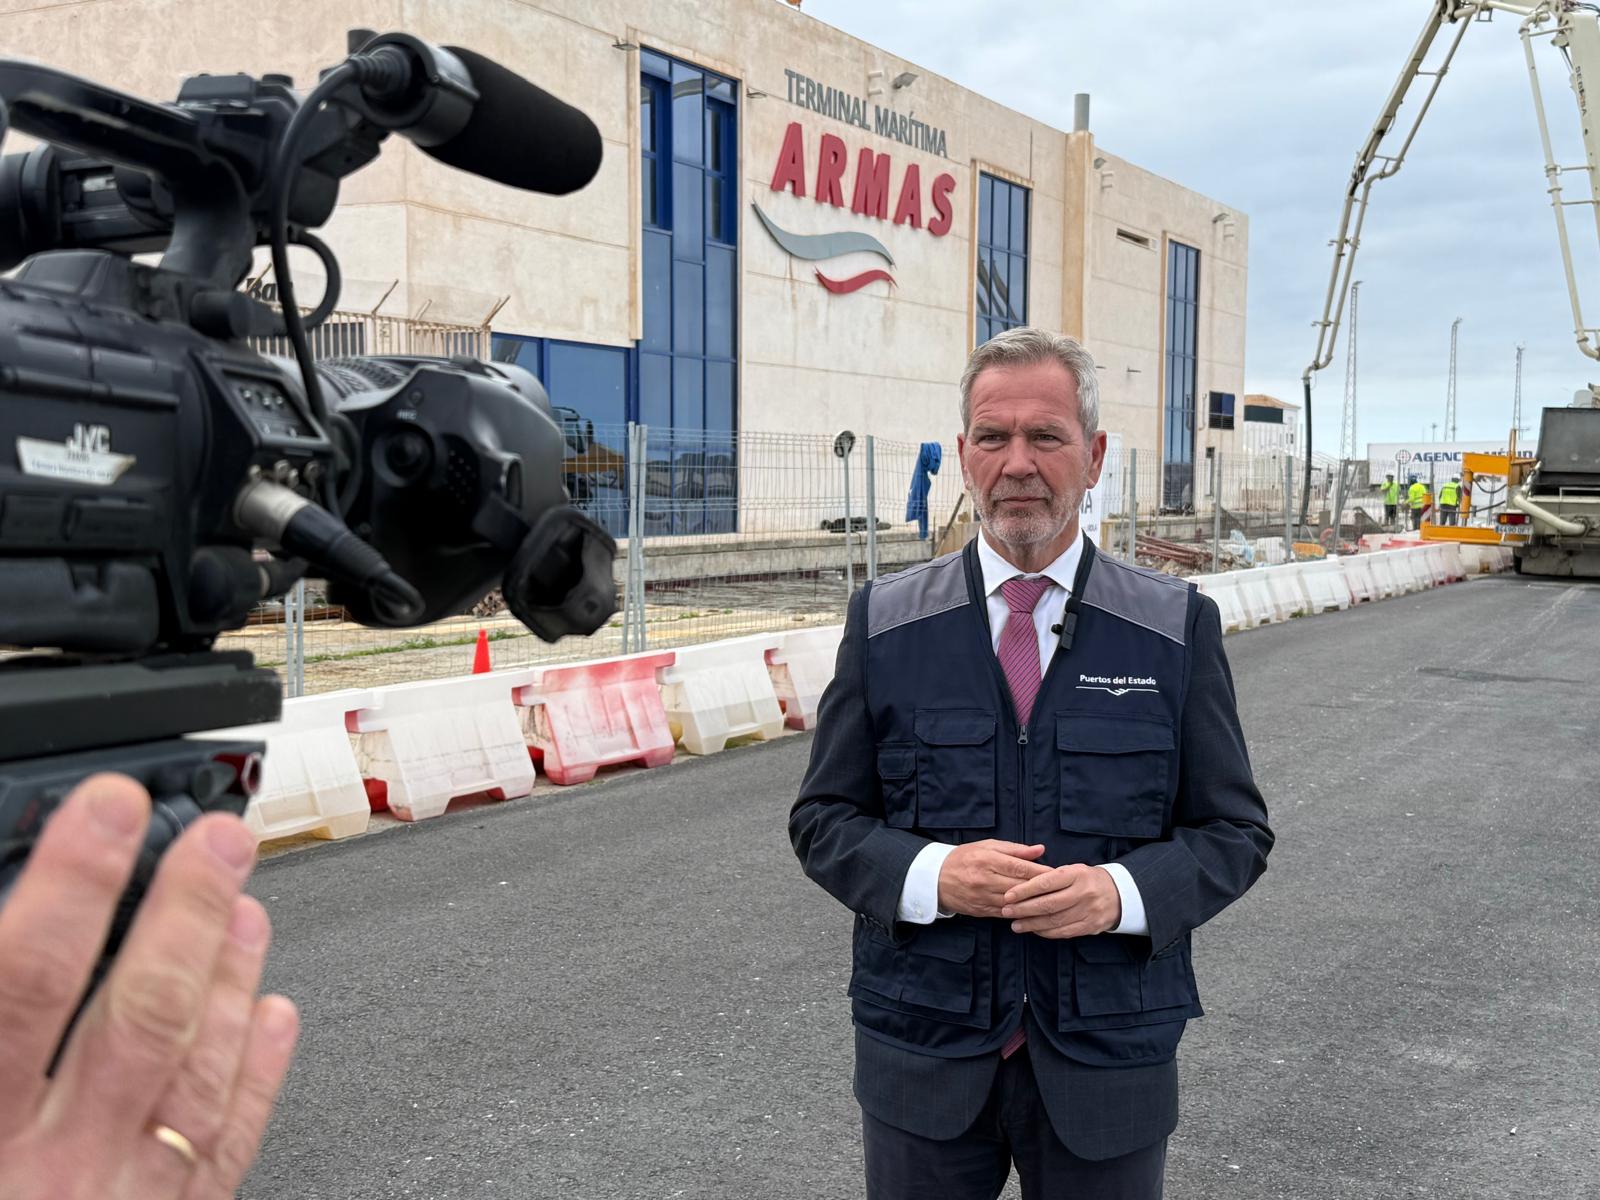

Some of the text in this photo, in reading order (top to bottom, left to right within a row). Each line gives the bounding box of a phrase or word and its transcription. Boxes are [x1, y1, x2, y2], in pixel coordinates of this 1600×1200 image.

[784, 68, 948, 159] TERMINAL MARÍTIMA
[770, 121, 957, 238] ARMAS
[65, 422, 110, 453] JVC
[1079, 674, 1157, 686] Puertos del Estado
